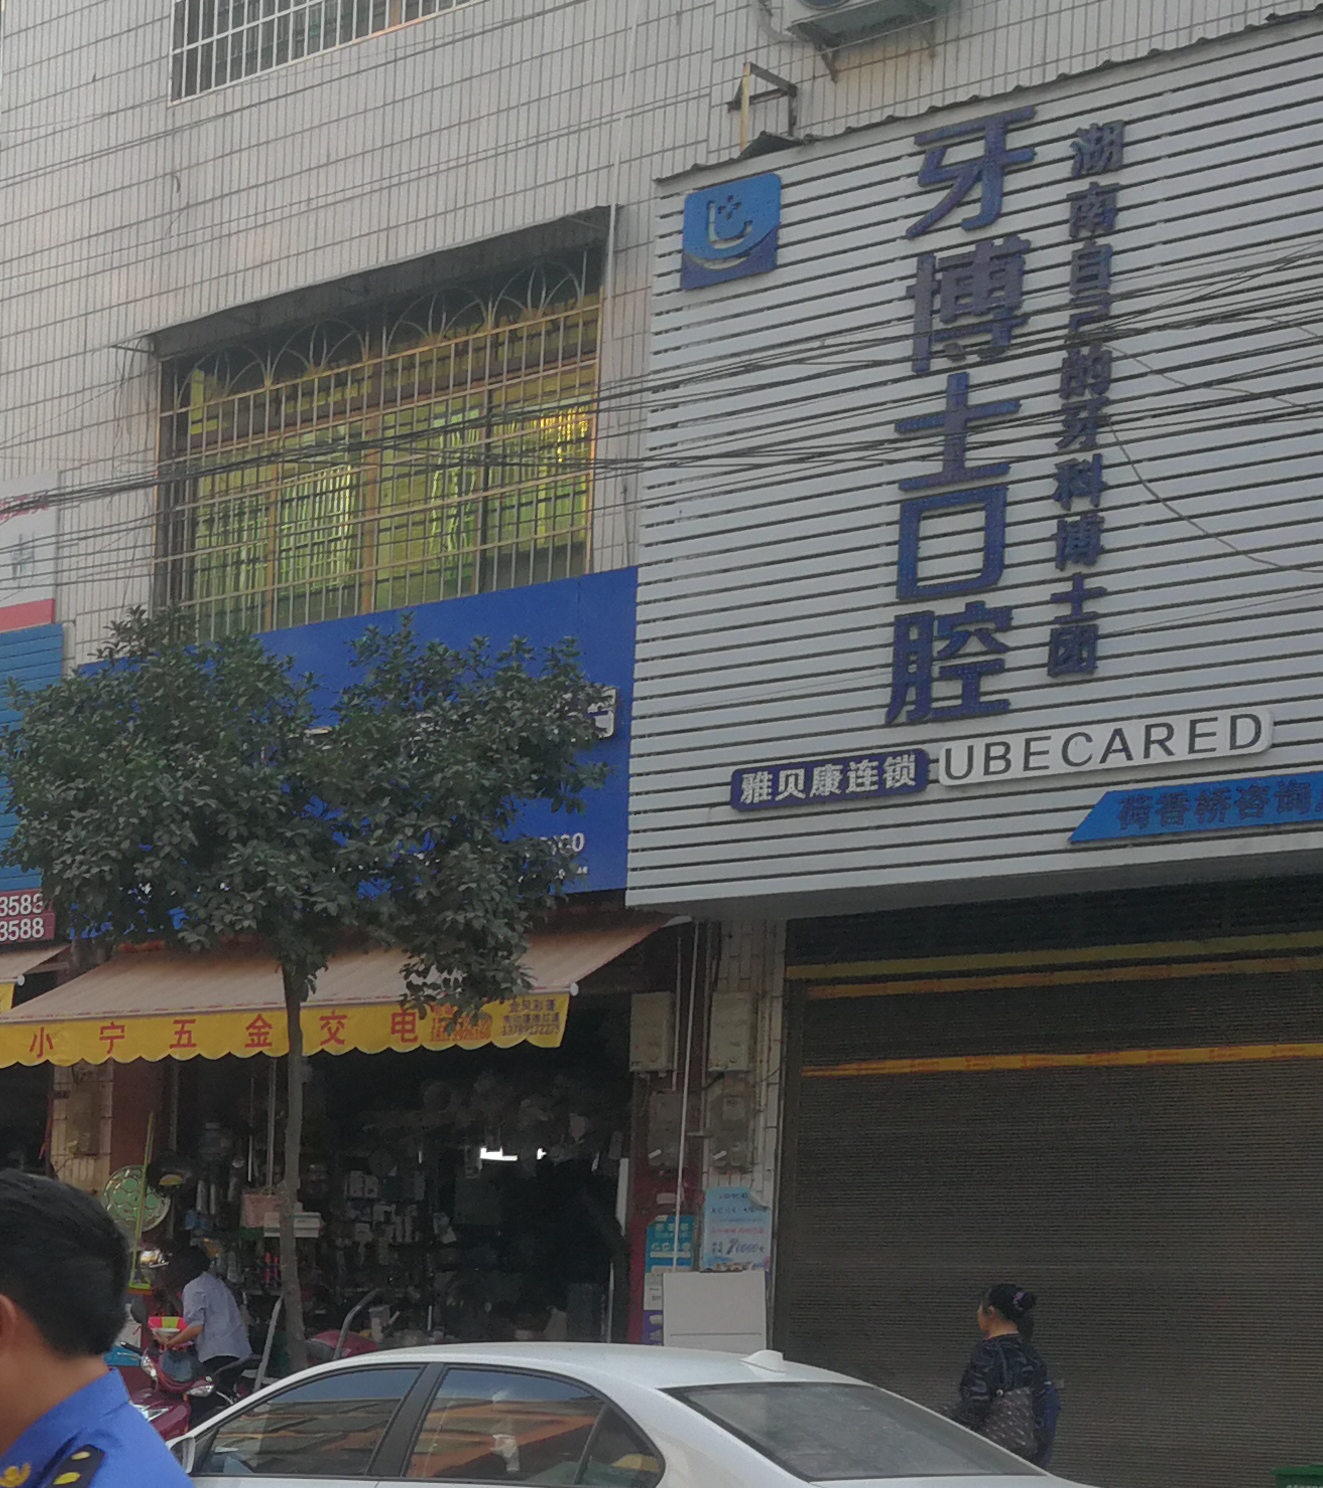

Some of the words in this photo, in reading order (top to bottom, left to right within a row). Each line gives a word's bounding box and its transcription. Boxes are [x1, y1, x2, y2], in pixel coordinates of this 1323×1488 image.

[883, 105, 1036, 724] 牙博士口腔
[943, 713, 1262, 781] UBECARED
[1117, 778, 1323, 831] 荷香桥咨询
